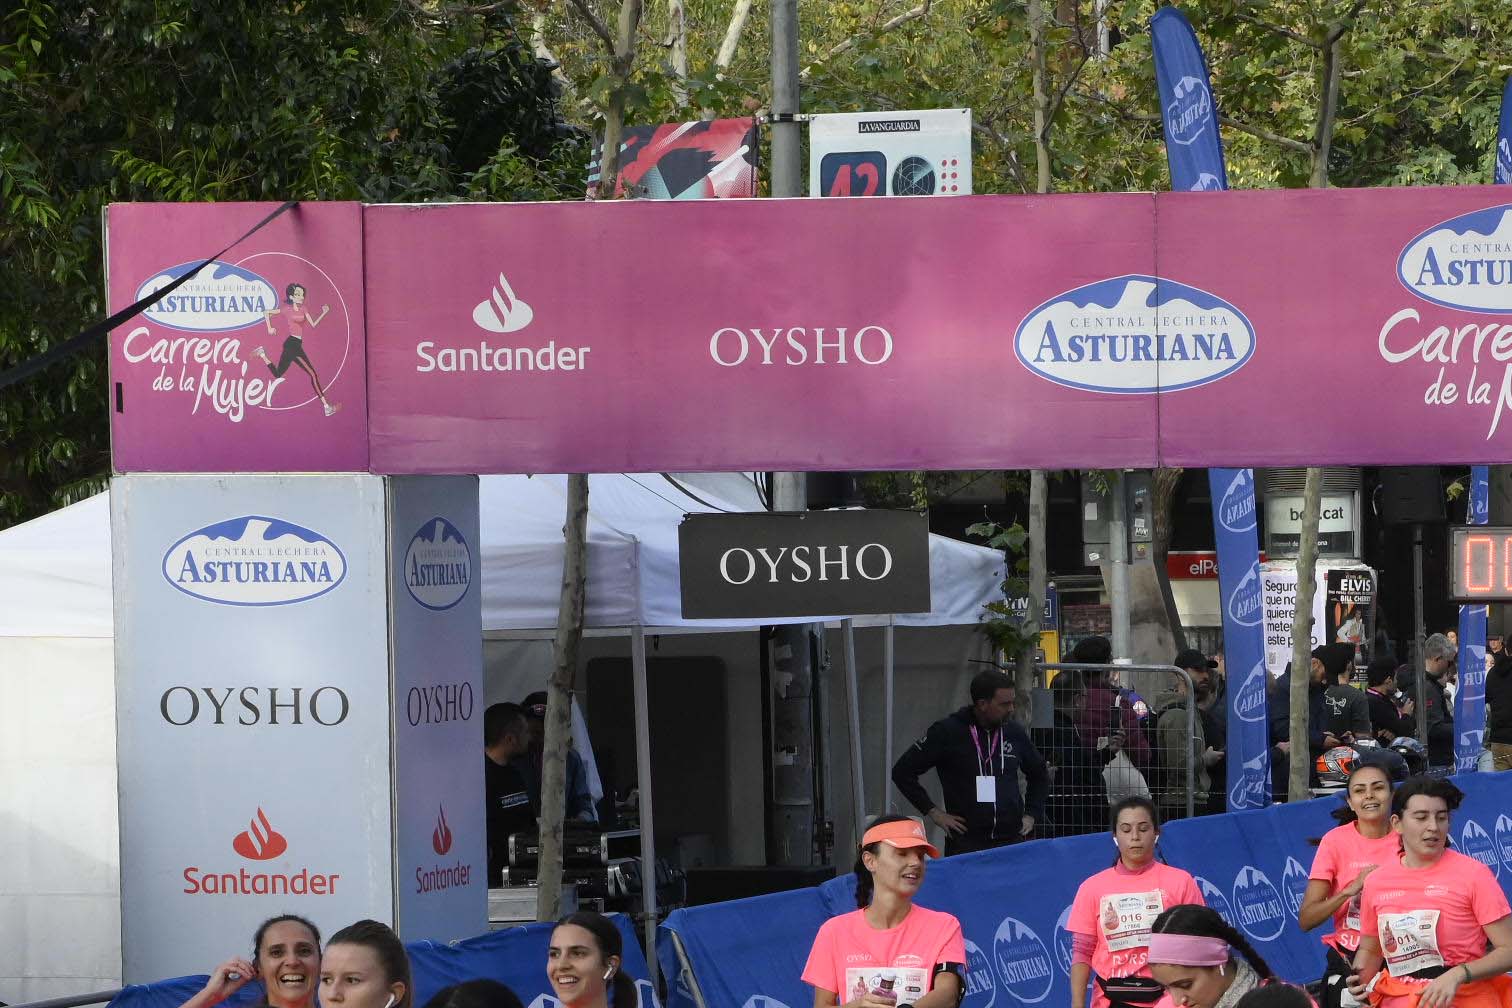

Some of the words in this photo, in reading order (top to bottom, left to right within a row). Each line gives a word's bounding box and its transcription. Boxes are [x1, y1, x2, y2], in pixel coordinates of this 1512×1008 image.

[147, 286, 267, 315] ASTURIANA
[1070, 315, 1143, 328] CENTRAL
[1152, 315, 1230, 328] LECHERA
[123, 326, 241, 365] Carrera
[416, 341, 591, 373] Santander
[709, 325, 893, 368] OYSHO
[1033, 319, 1237, 364] ASTURIANA
[152, 366, 176, 392] de
[178, 365, 194, 392] la
[192, 364, 286, 422] Mujer
[1424, 366, 1458, 406] de
[1466, 364, 1491, 406] la
[177, 549, 334, 584] ASTURIANA
[205, 547, 263, 556] CENTRAL
[267, 547, 328, 556] LECHERA
[719, 543, 893, 585] OYSHO
[409, 555, 468, 588] ASTURIANA
[1340, 579, 1371, 592] ELVIS
[1340, 595, 1353, 603] BILL
[1267, 634, 1286, 646] este
[160, 686, 350, 727] OYSHO
[406, 681, 474, 727] OYSHO
[183, 866, 340, 896] Santander
[415, 860, 472, 895] Santander
[1120, 913, 1143, 923] 016
[1237, 895, 1284, 926] ASTURIANA
[998, 952, 1051, 985] ASTURIANA
